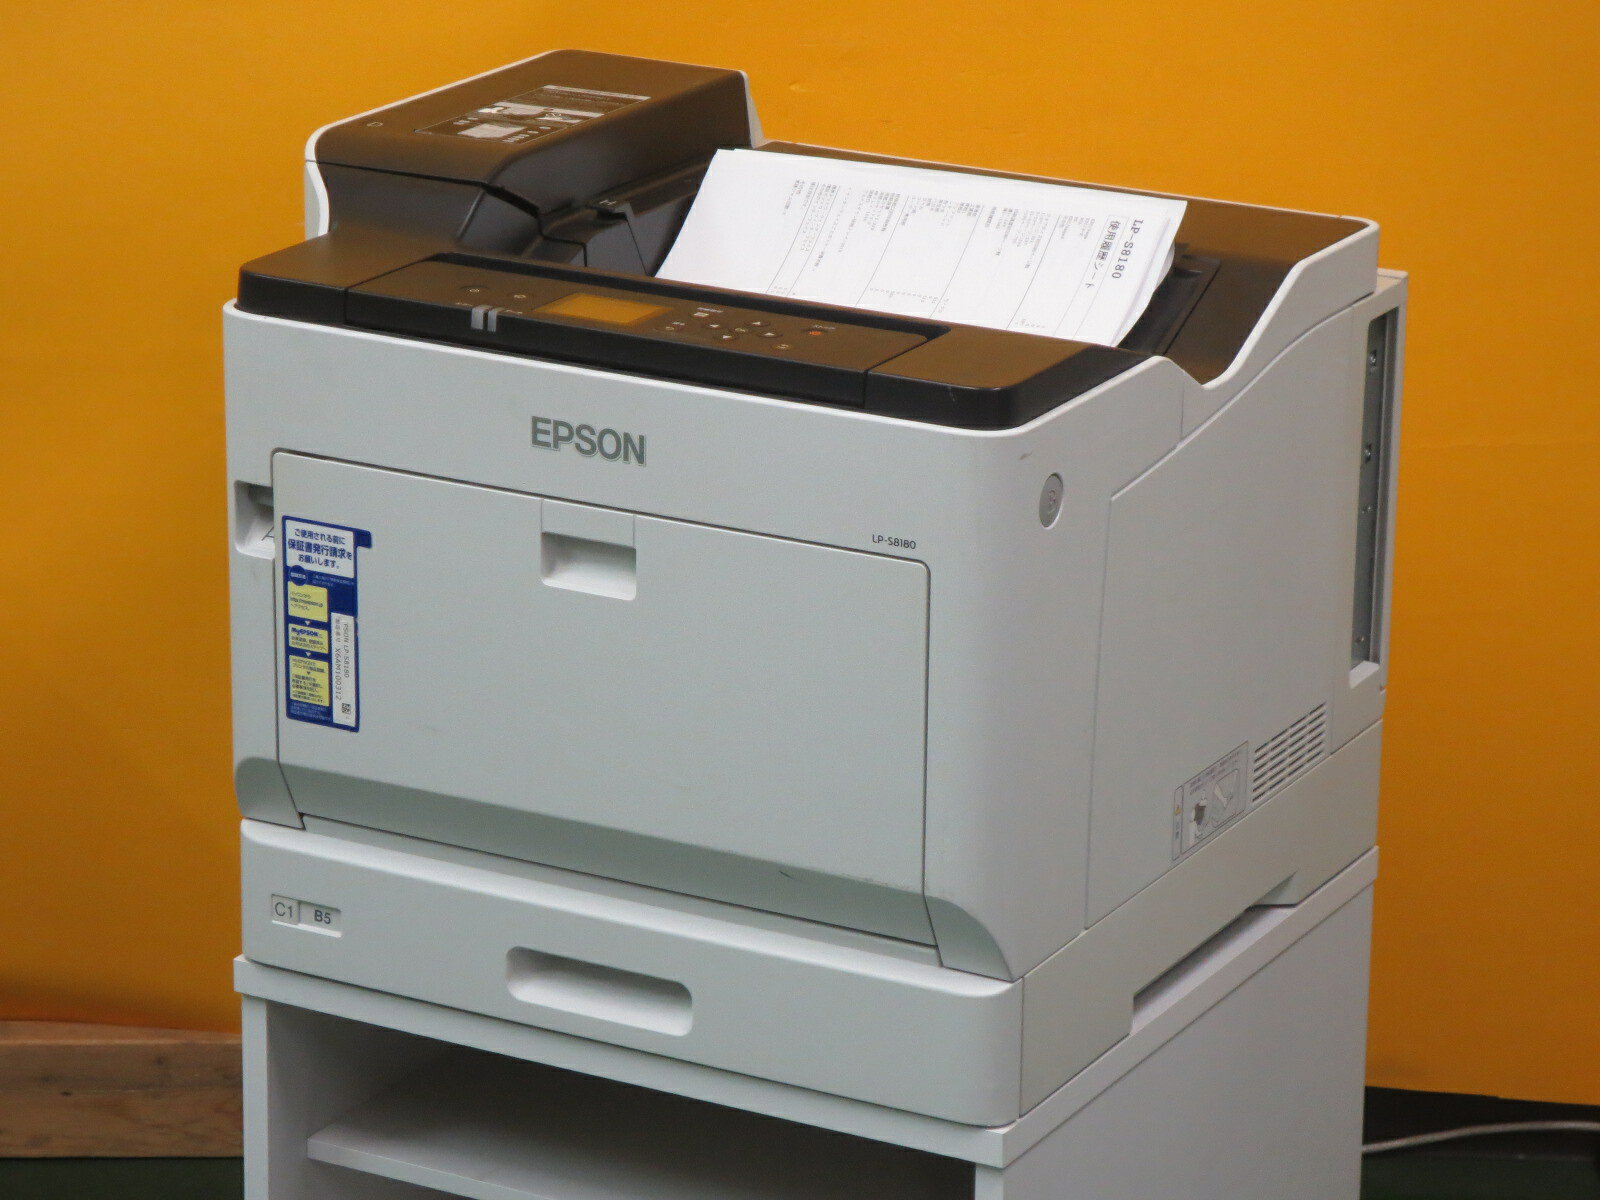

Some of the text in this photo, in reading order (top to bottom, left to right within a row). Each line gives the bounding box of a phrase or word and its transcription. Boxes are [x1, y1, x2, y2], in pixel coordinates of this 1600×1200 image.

[1085, 220, 1121, 288] 使用履歴シート
[1112, 219, 1143, 279] LP-S8180
[531, 415, 647, 467] EPSON
[294, 528, 346, 545] ご使用される前に
[872, 534, 916, 550] LP-S8180
[288, 538, 352, 560] 保証書発行請求を
[298, 554, 340, 569] お願いします。
[274, 901, 293, 918] C1
[314, 909, 331, 925] B5
